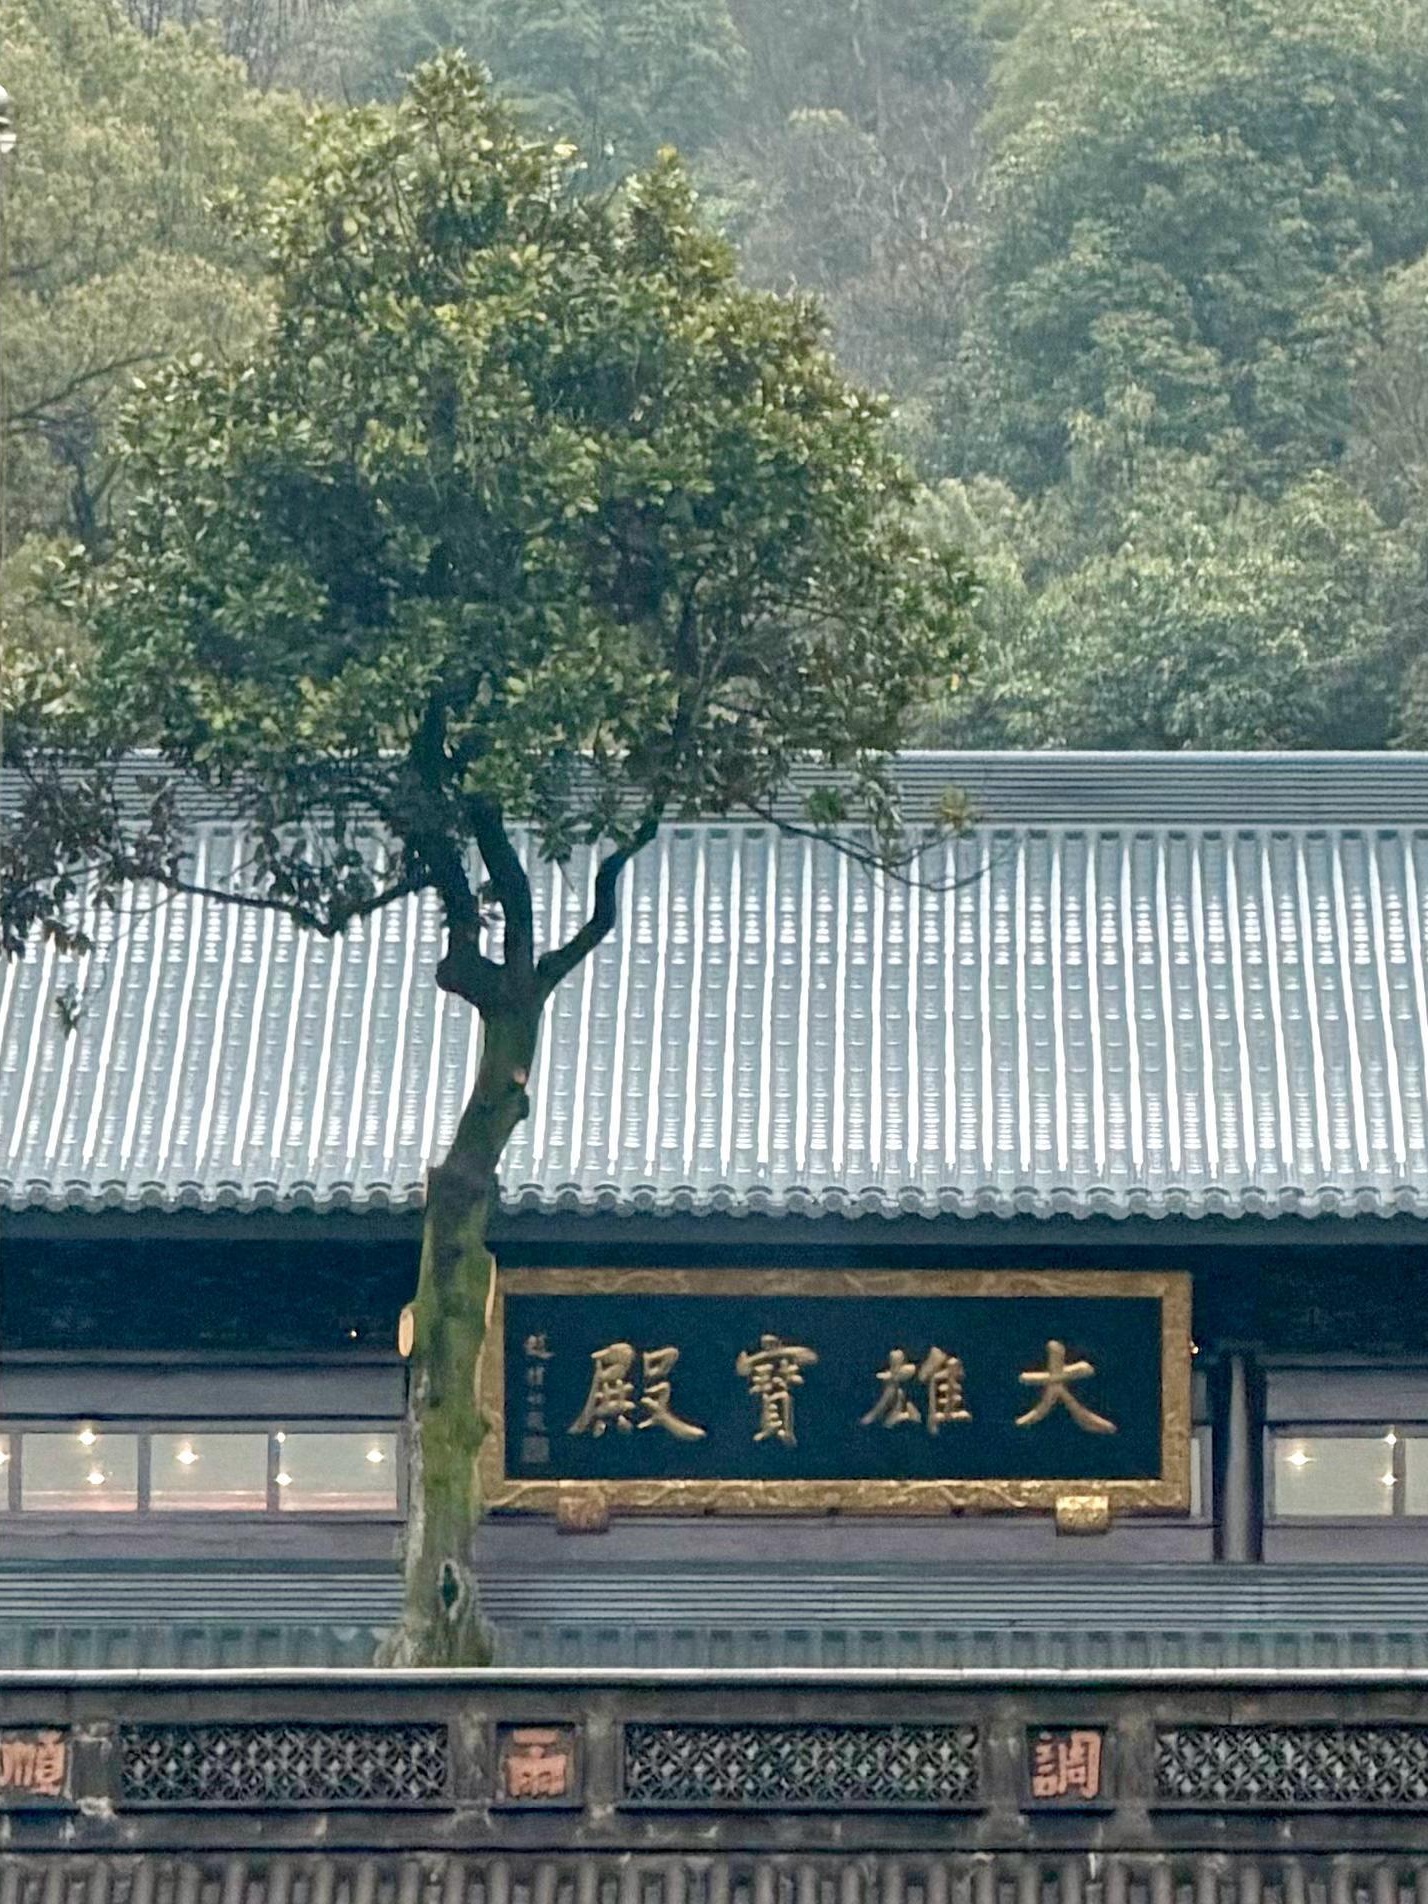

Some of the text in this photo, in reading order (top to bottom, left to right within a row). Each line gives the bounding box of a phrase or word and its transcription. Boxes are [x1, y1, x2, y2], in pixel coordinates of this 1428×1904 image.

[568, 1333, 1118, 1447] 大雄寶殿
[1032, 1730, 1101, 1798] 調
